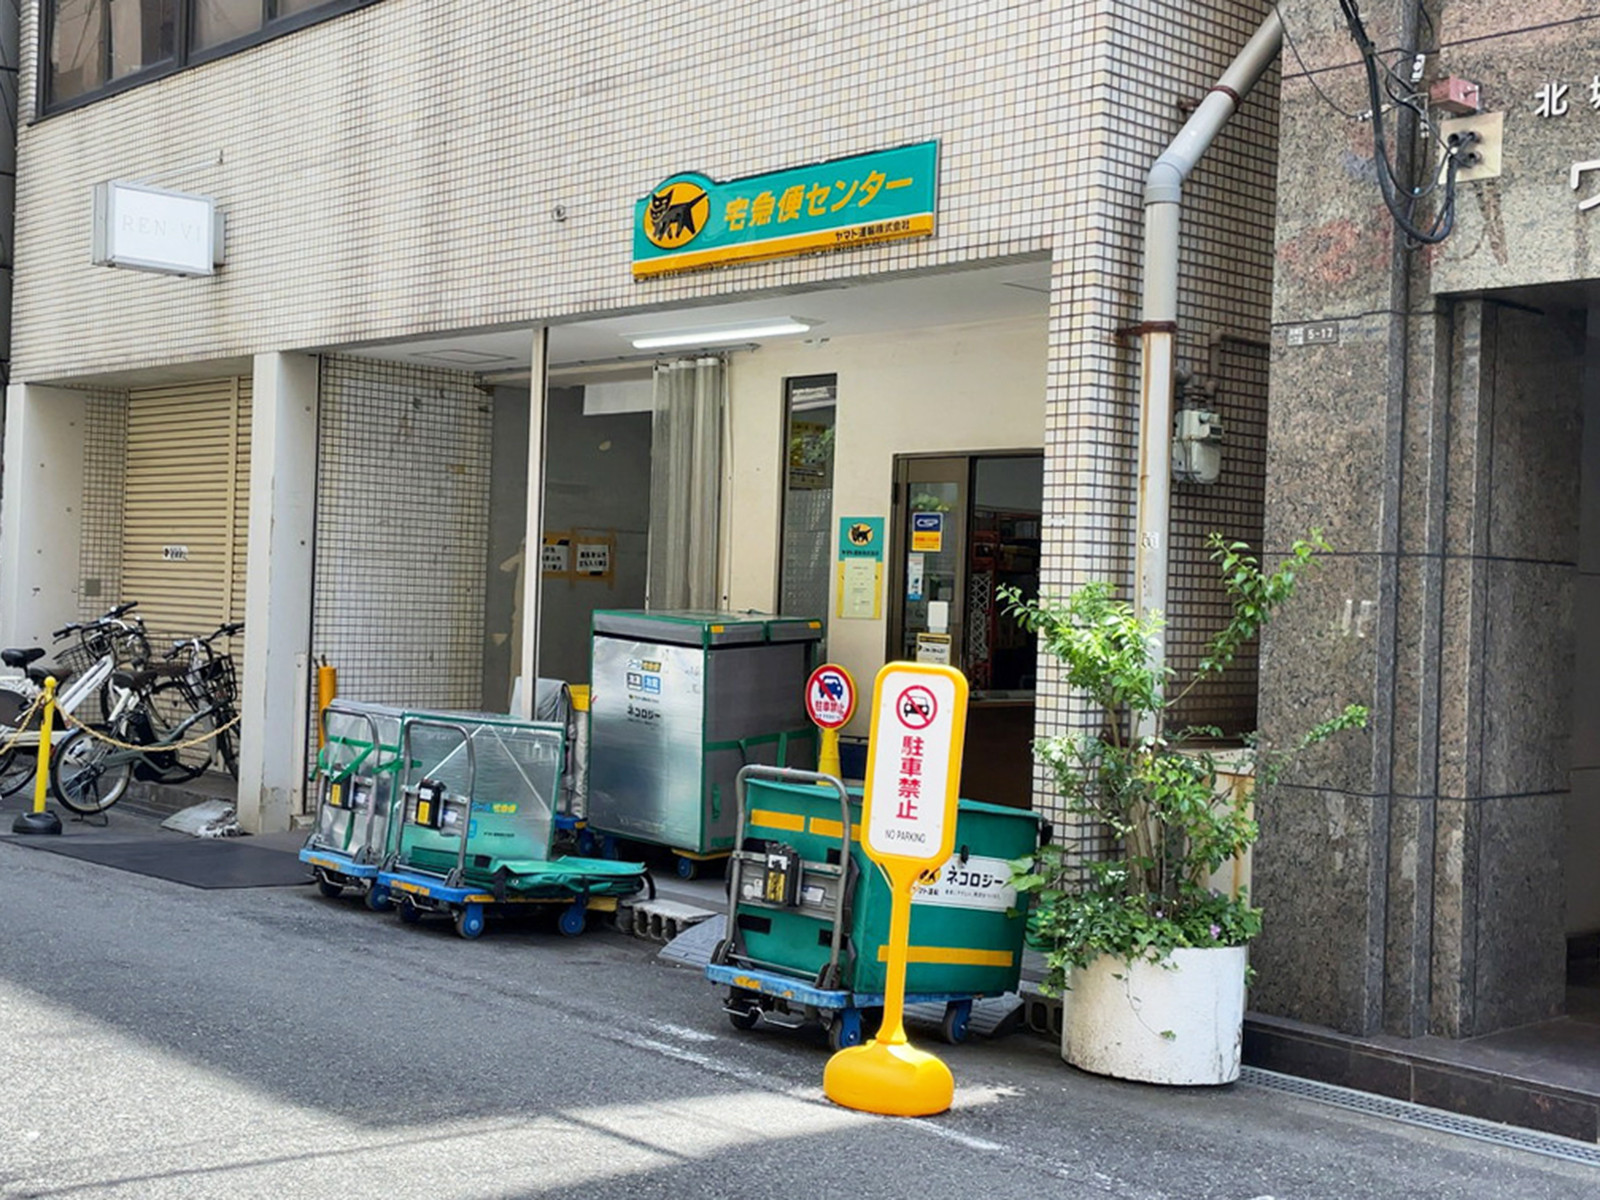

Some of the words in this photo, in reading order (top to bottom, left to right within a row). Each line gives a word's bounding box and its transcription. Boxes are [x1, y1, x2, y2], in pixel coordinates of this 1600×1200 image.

[723, 170, 913, 232] 宅急便センター
[122, 214, 168, 237] REN
[835, 218, 910, 241] ヤマト運輸株式会社
[1307, 327, 1333, 340] 5-17
[627, 703, 661, 720] ネコロジー
[815, 700, 845, 715] 駐車禁止
[896, 735, 925, 820] 駐車禁止
[885, 829, 895, 840] NO
[897, 830, 926, 844] PARKING
[946, 865, 1004, 888] ネコロジー
